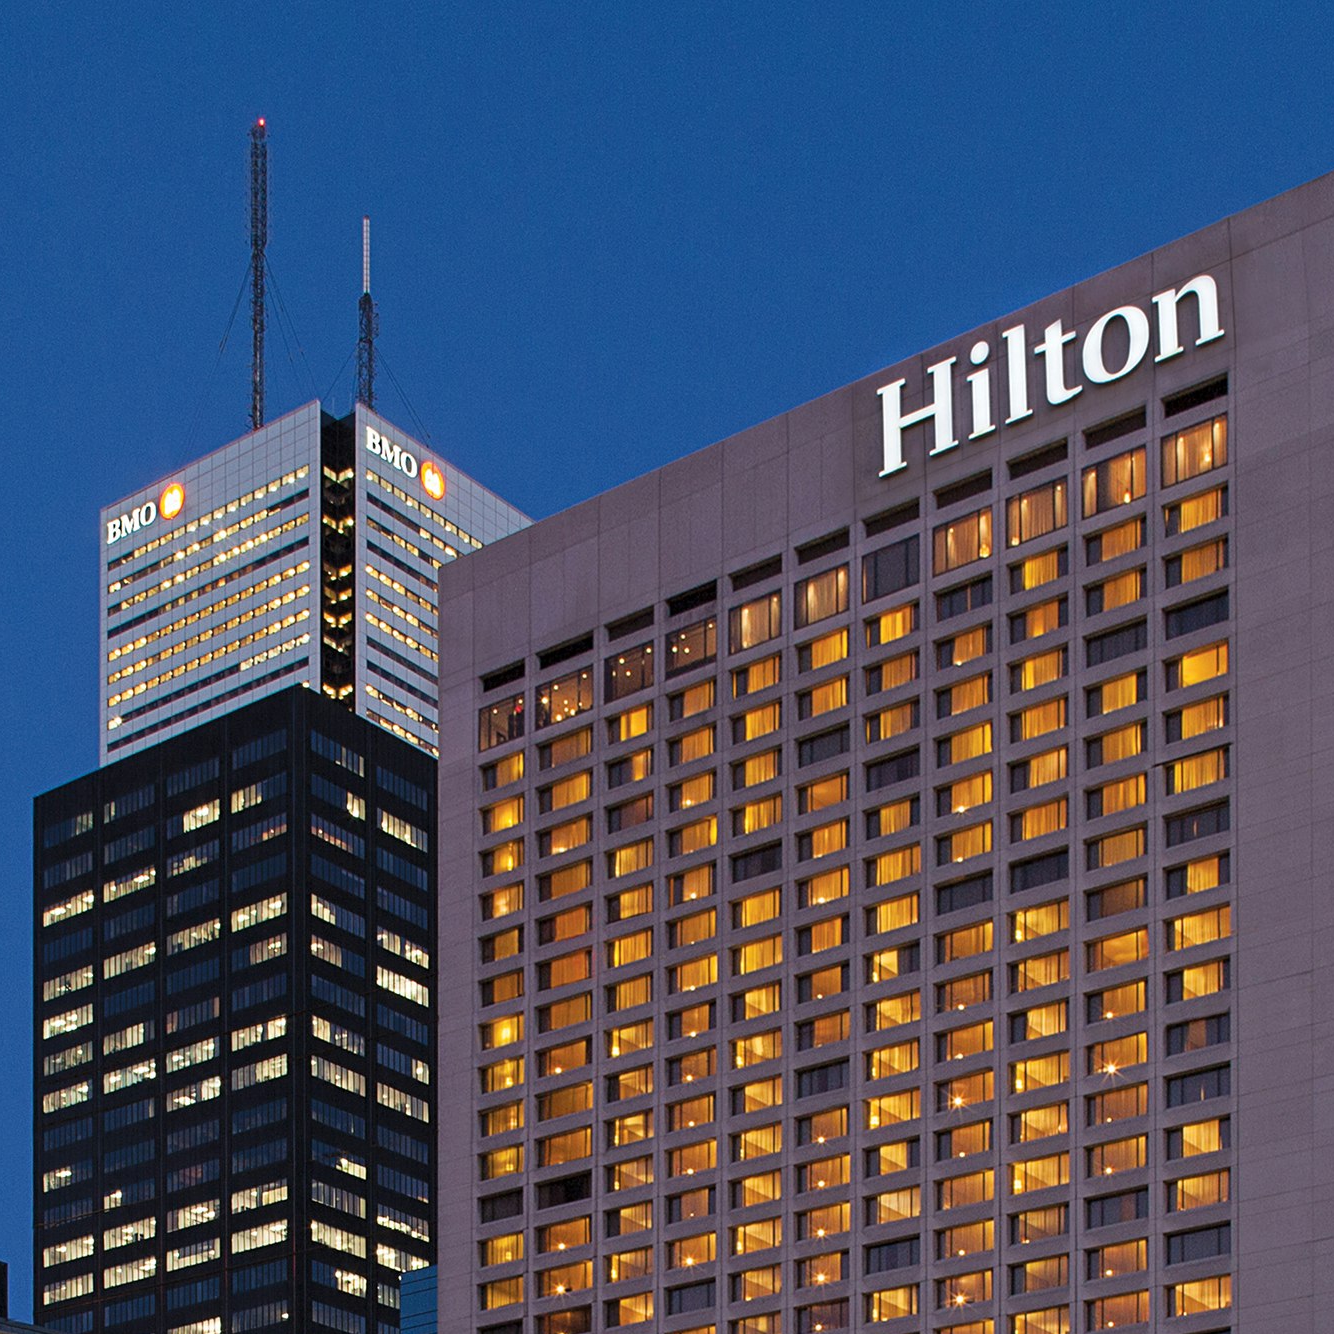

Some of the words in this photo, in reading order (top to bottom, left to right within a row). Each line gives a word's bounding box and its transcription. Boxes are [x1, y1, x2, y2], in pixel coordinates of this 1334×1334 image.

[876, 274, 1225, 478] Hilton
[365, 425, 418, 479] BMO
[106, 501, 157, 545] BMO
